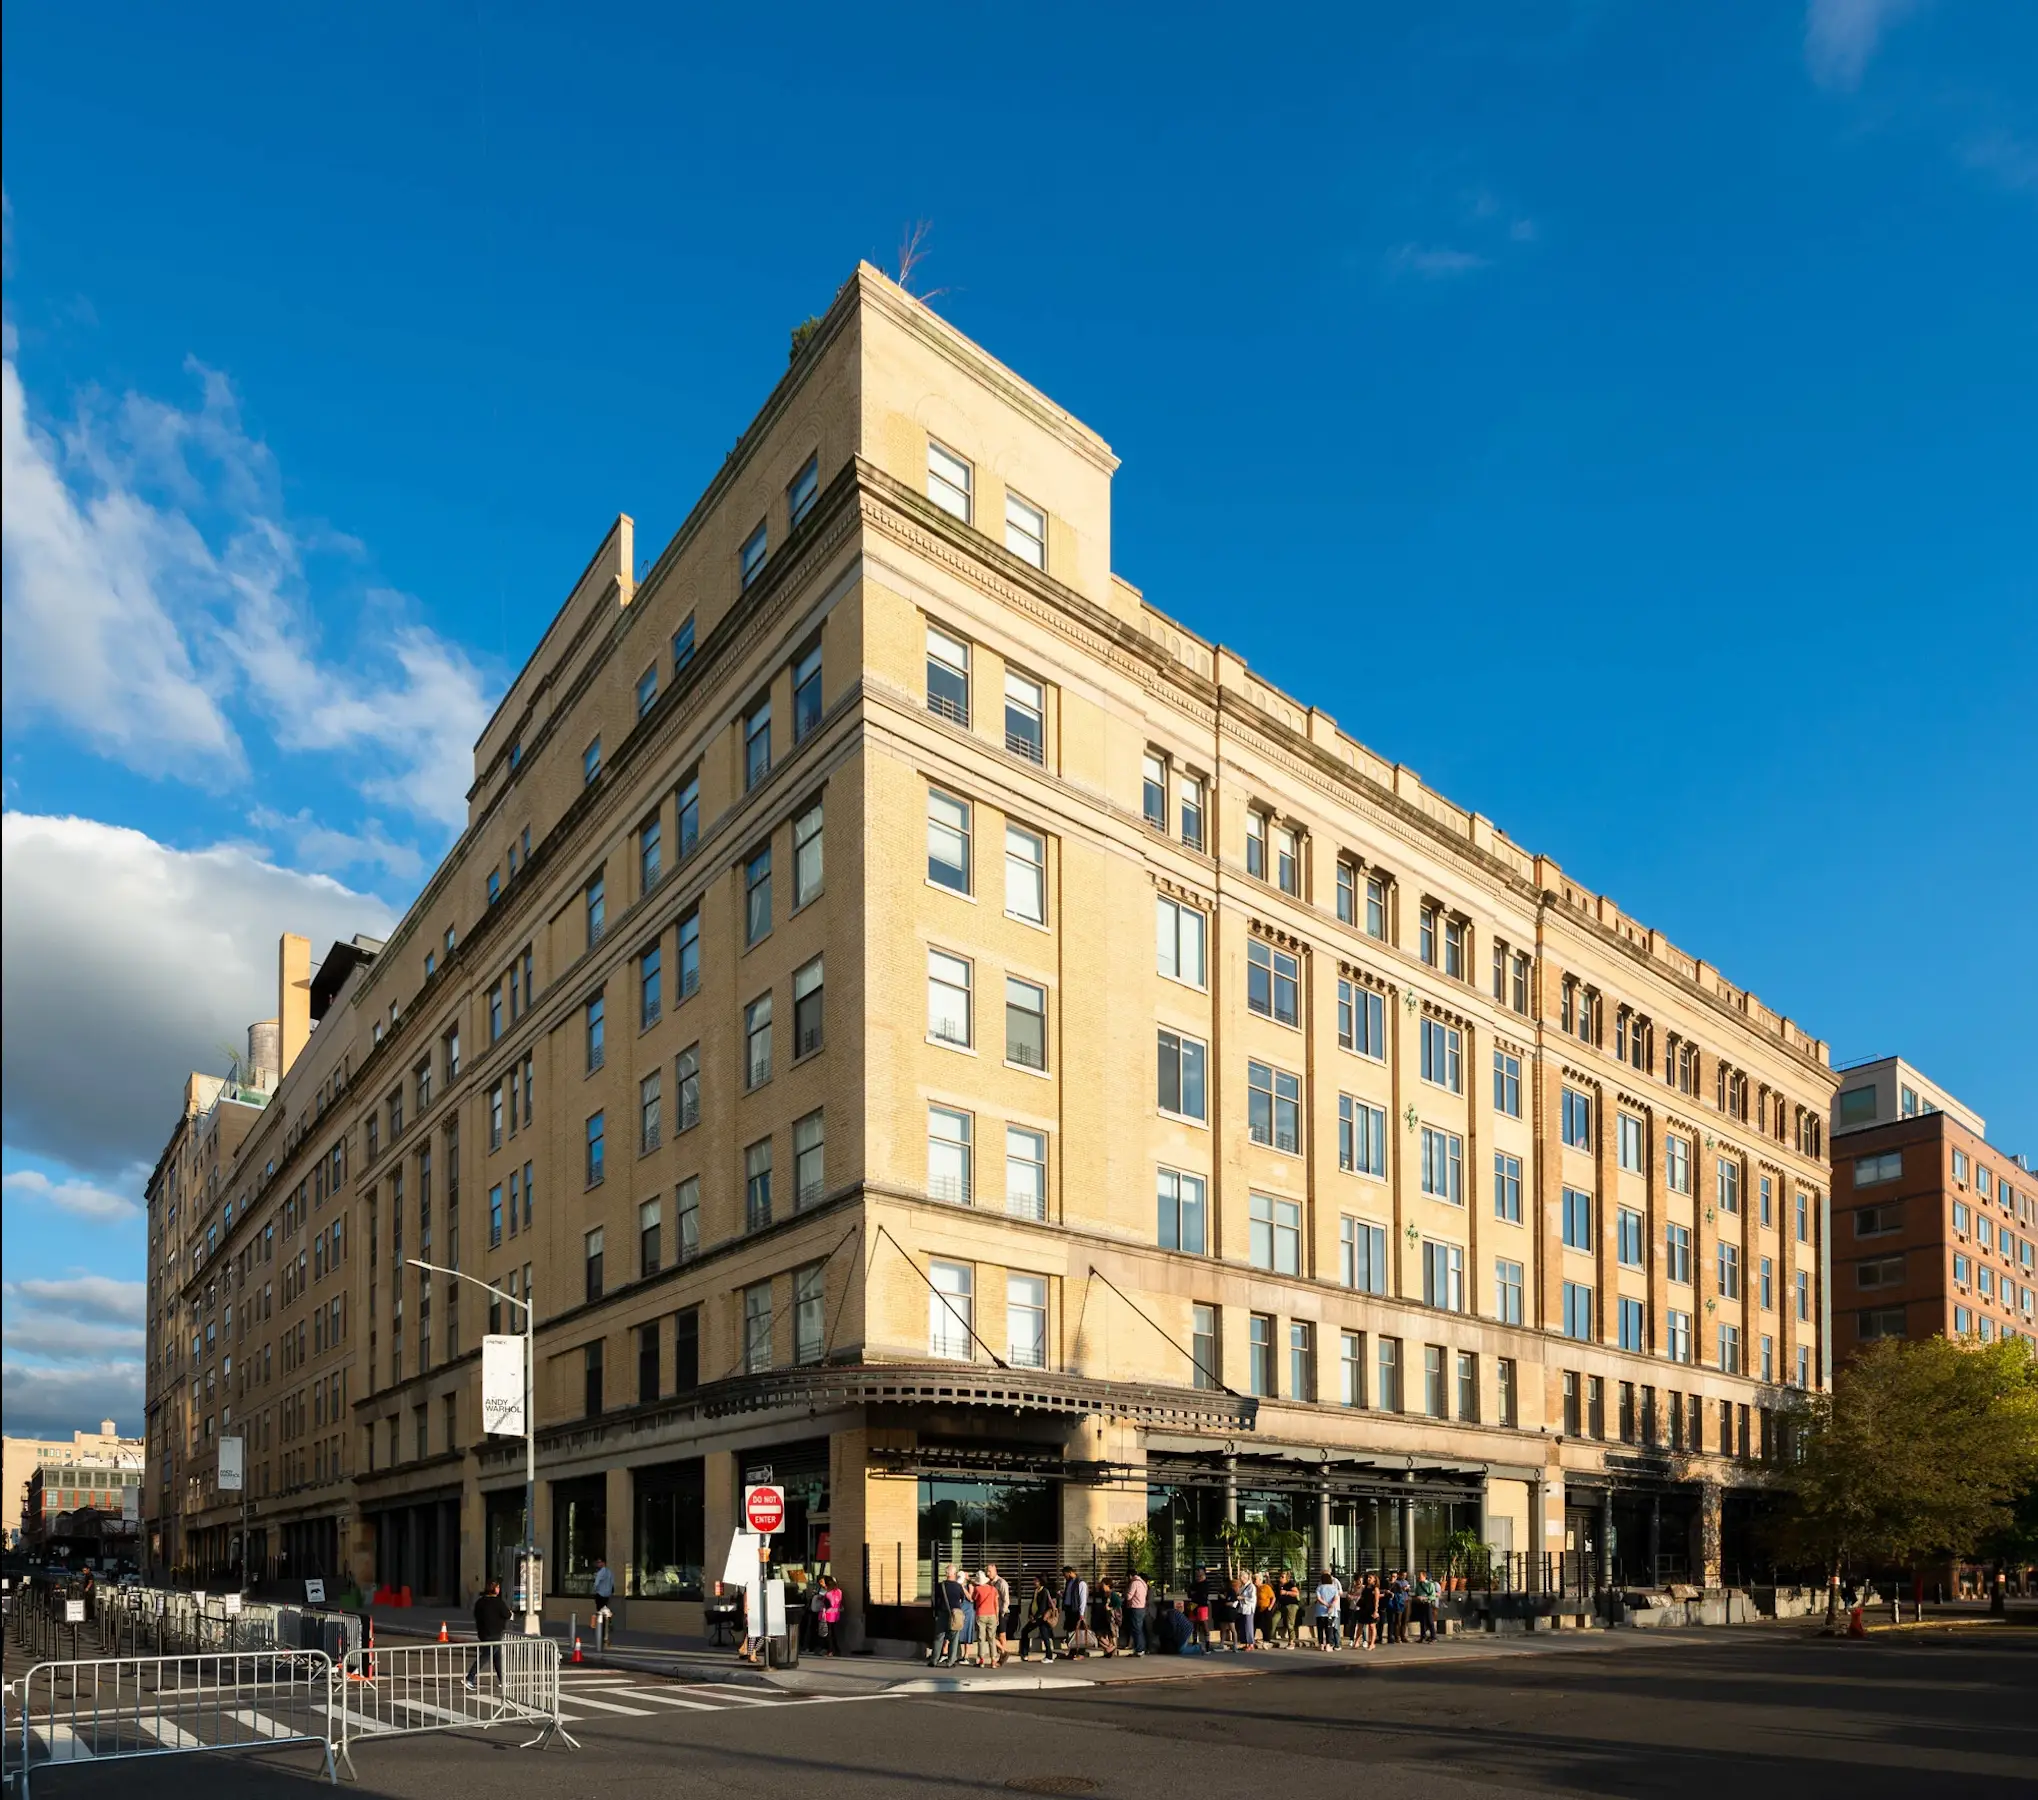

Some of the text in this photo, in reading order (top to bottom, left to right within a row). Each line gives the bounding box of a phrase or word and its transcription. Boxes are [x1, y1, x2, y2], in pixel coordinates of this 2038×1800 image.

[485, 1405, 522, 1413] WARHOL
[752, 1495, 777, 1503] DO NOT
